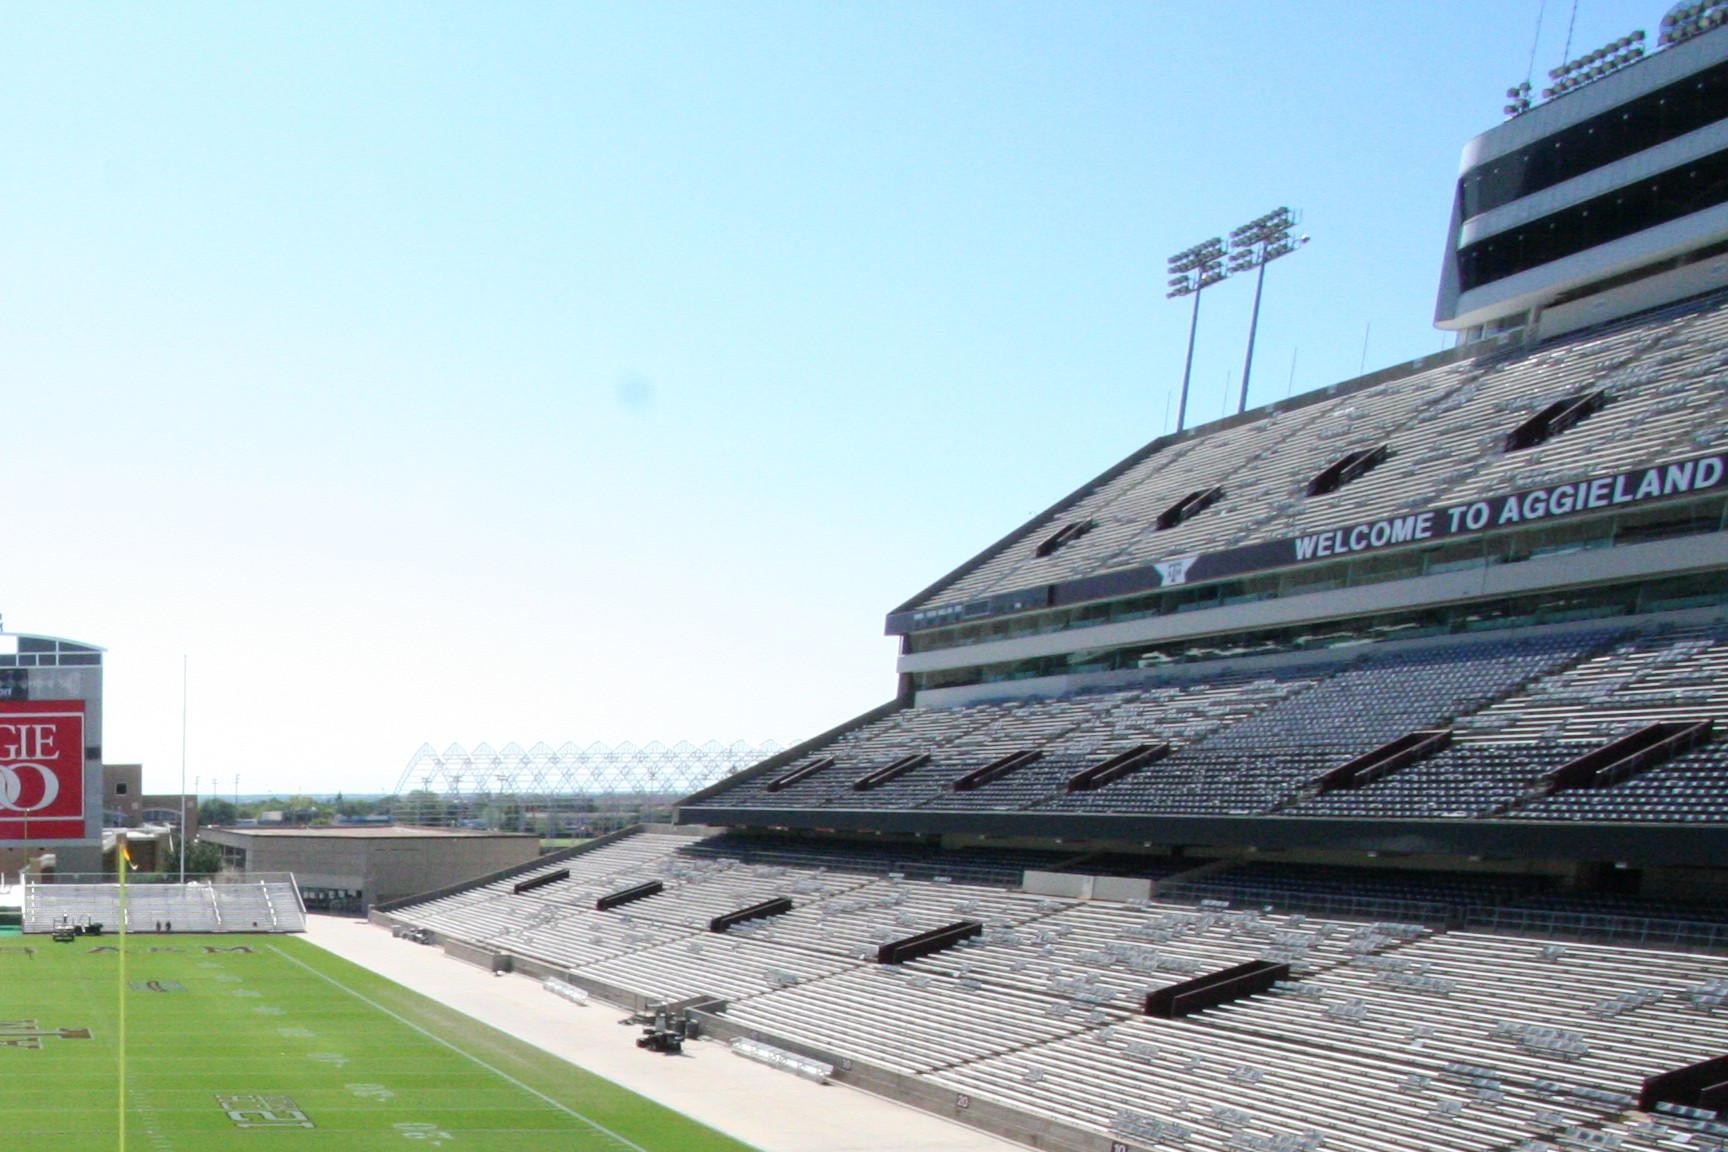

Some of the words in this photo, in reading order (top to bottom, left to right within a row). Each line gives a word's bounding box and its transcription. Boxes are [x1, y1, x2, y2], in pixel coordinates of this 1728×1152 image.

[1294, 511, 1435, 560] WELCOME
[1448, 501, 1490, 533] TO
[1498, 456, 1723, 524] AGGIELAND
